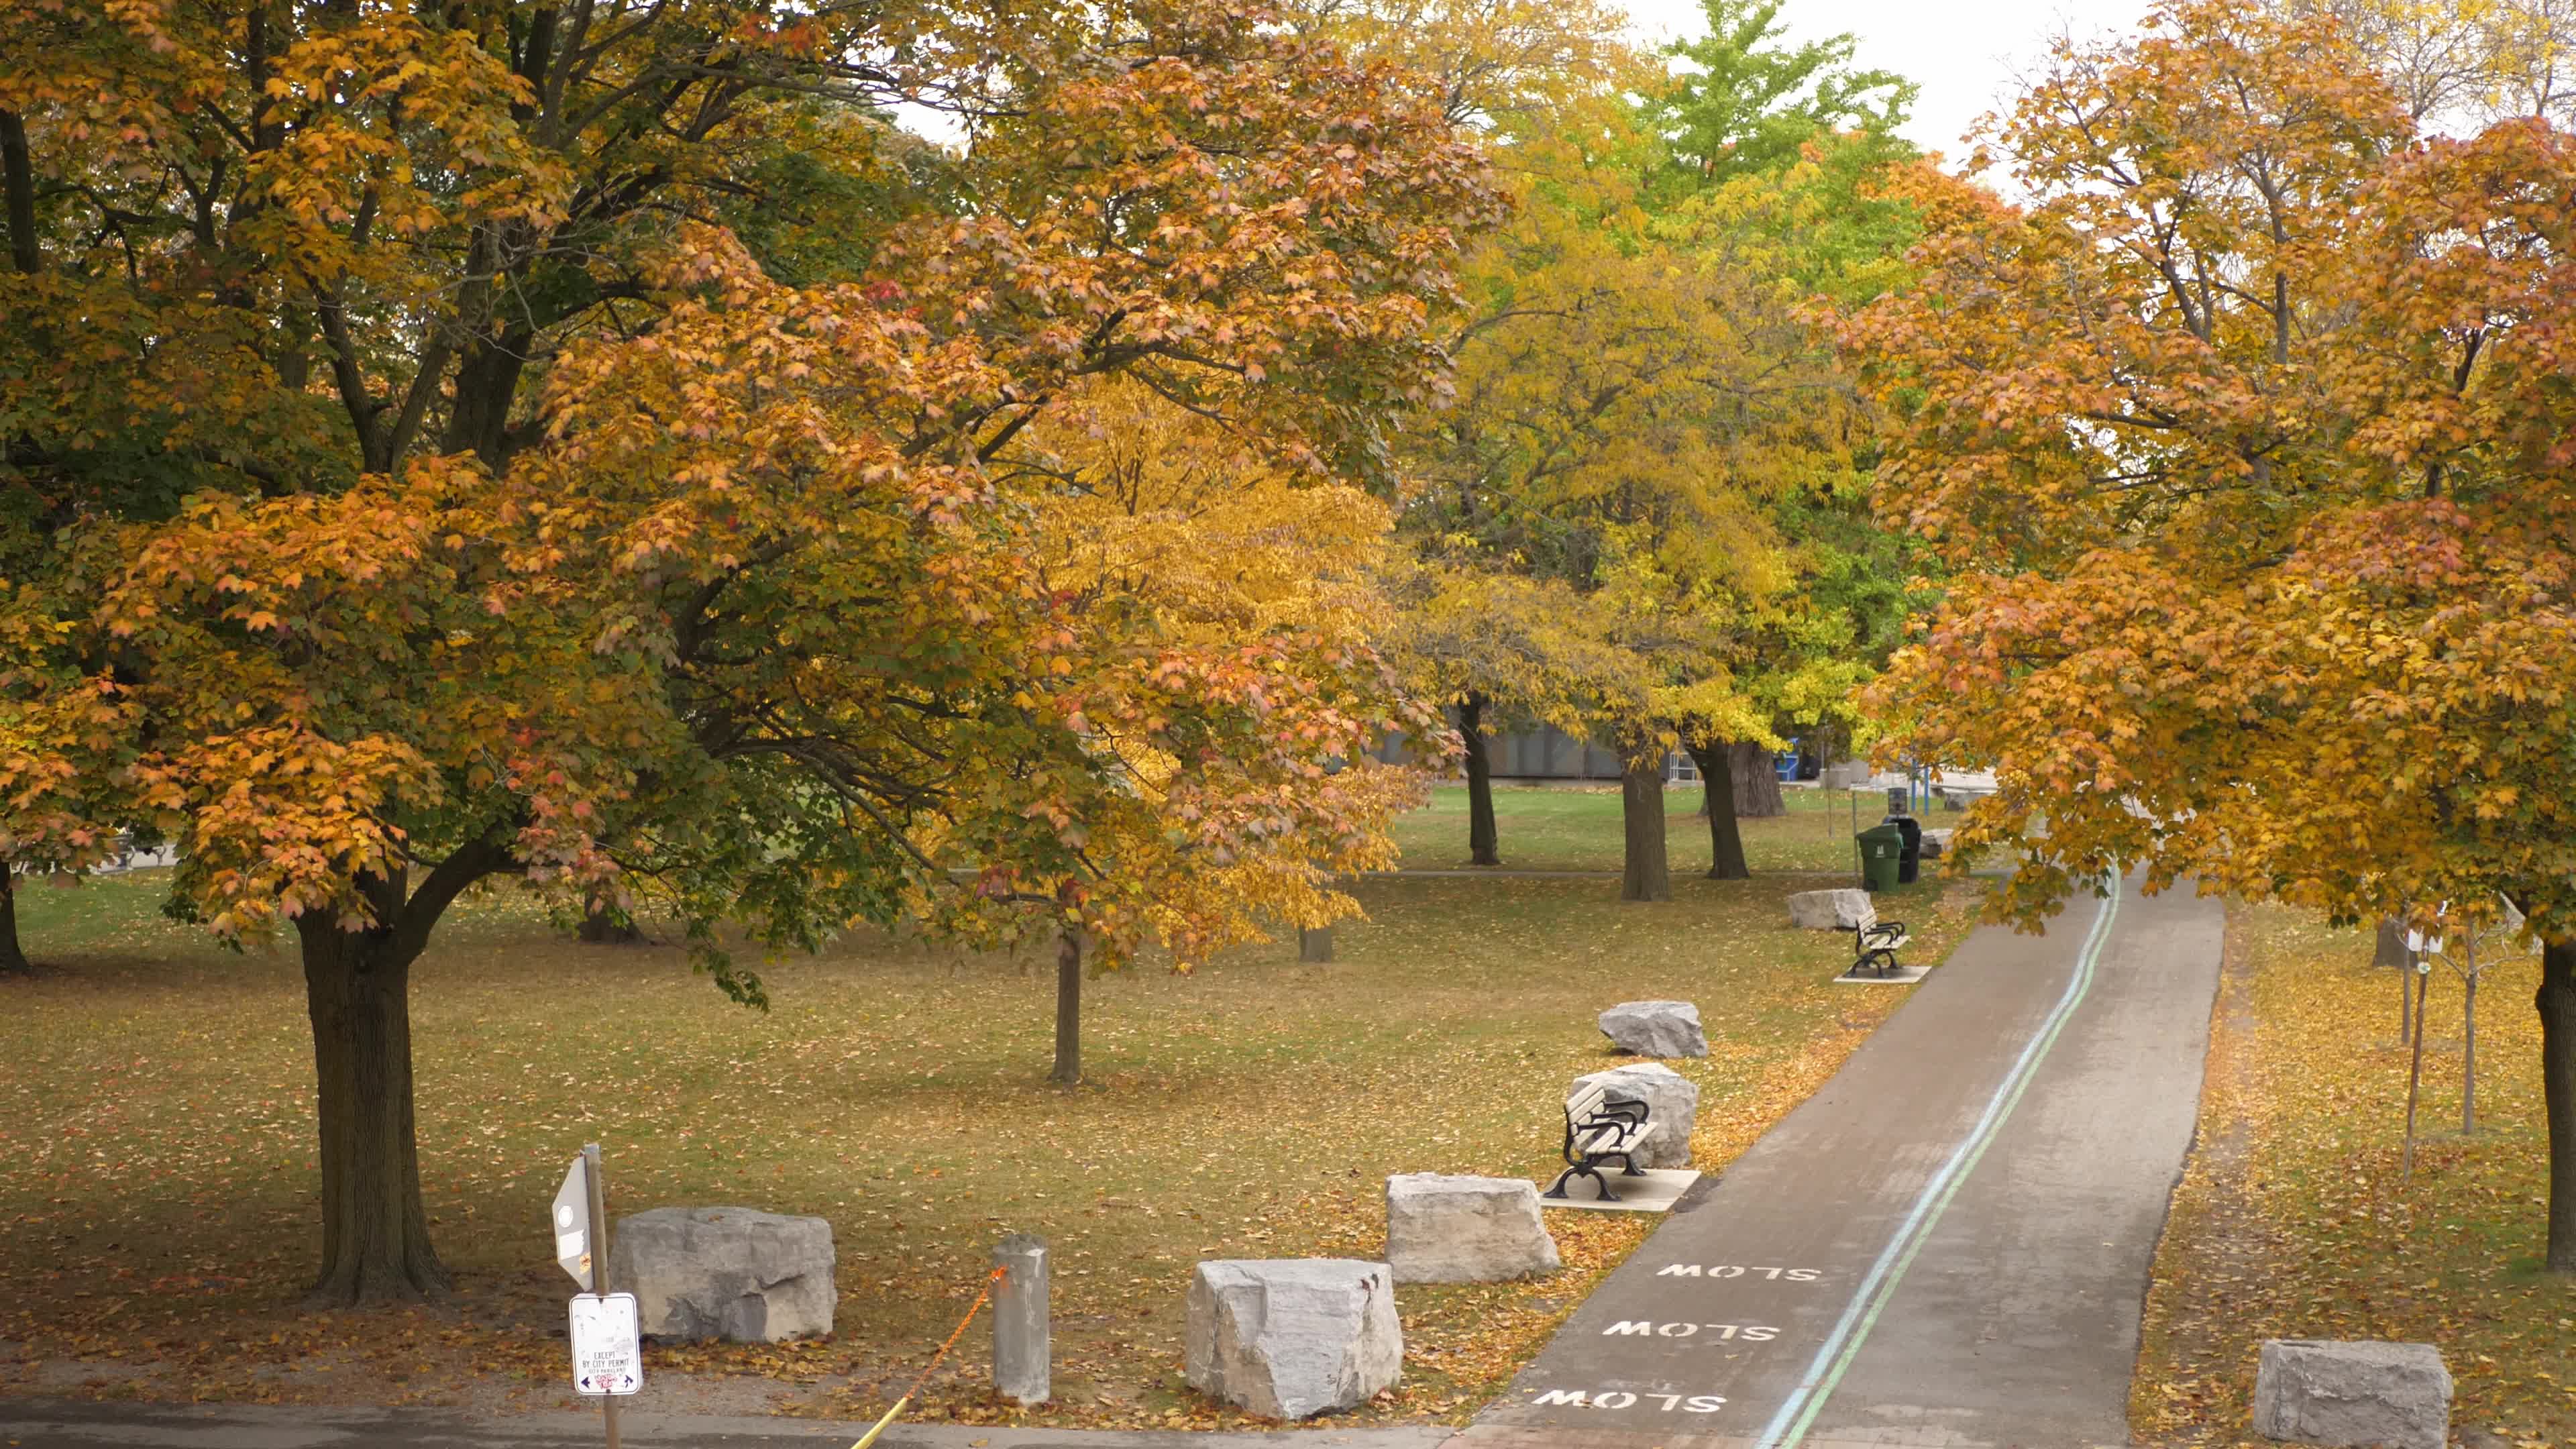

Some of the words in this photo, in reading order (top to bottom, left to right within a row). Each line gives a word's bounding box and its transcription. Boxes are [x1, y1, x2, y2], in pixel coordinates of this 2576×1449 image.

[1656, 1264, 1822, 1281] SLOW
[1602, 1320, 1781, 1341] SLOW
[582, 1360, 590, 1368] BY
[592, 1359, 605, 1368] CITY
[608, 1358, 629, 1368] PERMIT
[594, 1351, 615, 1360] EXCEPT
[1530, 1389, 1727, 1413] SLOW
